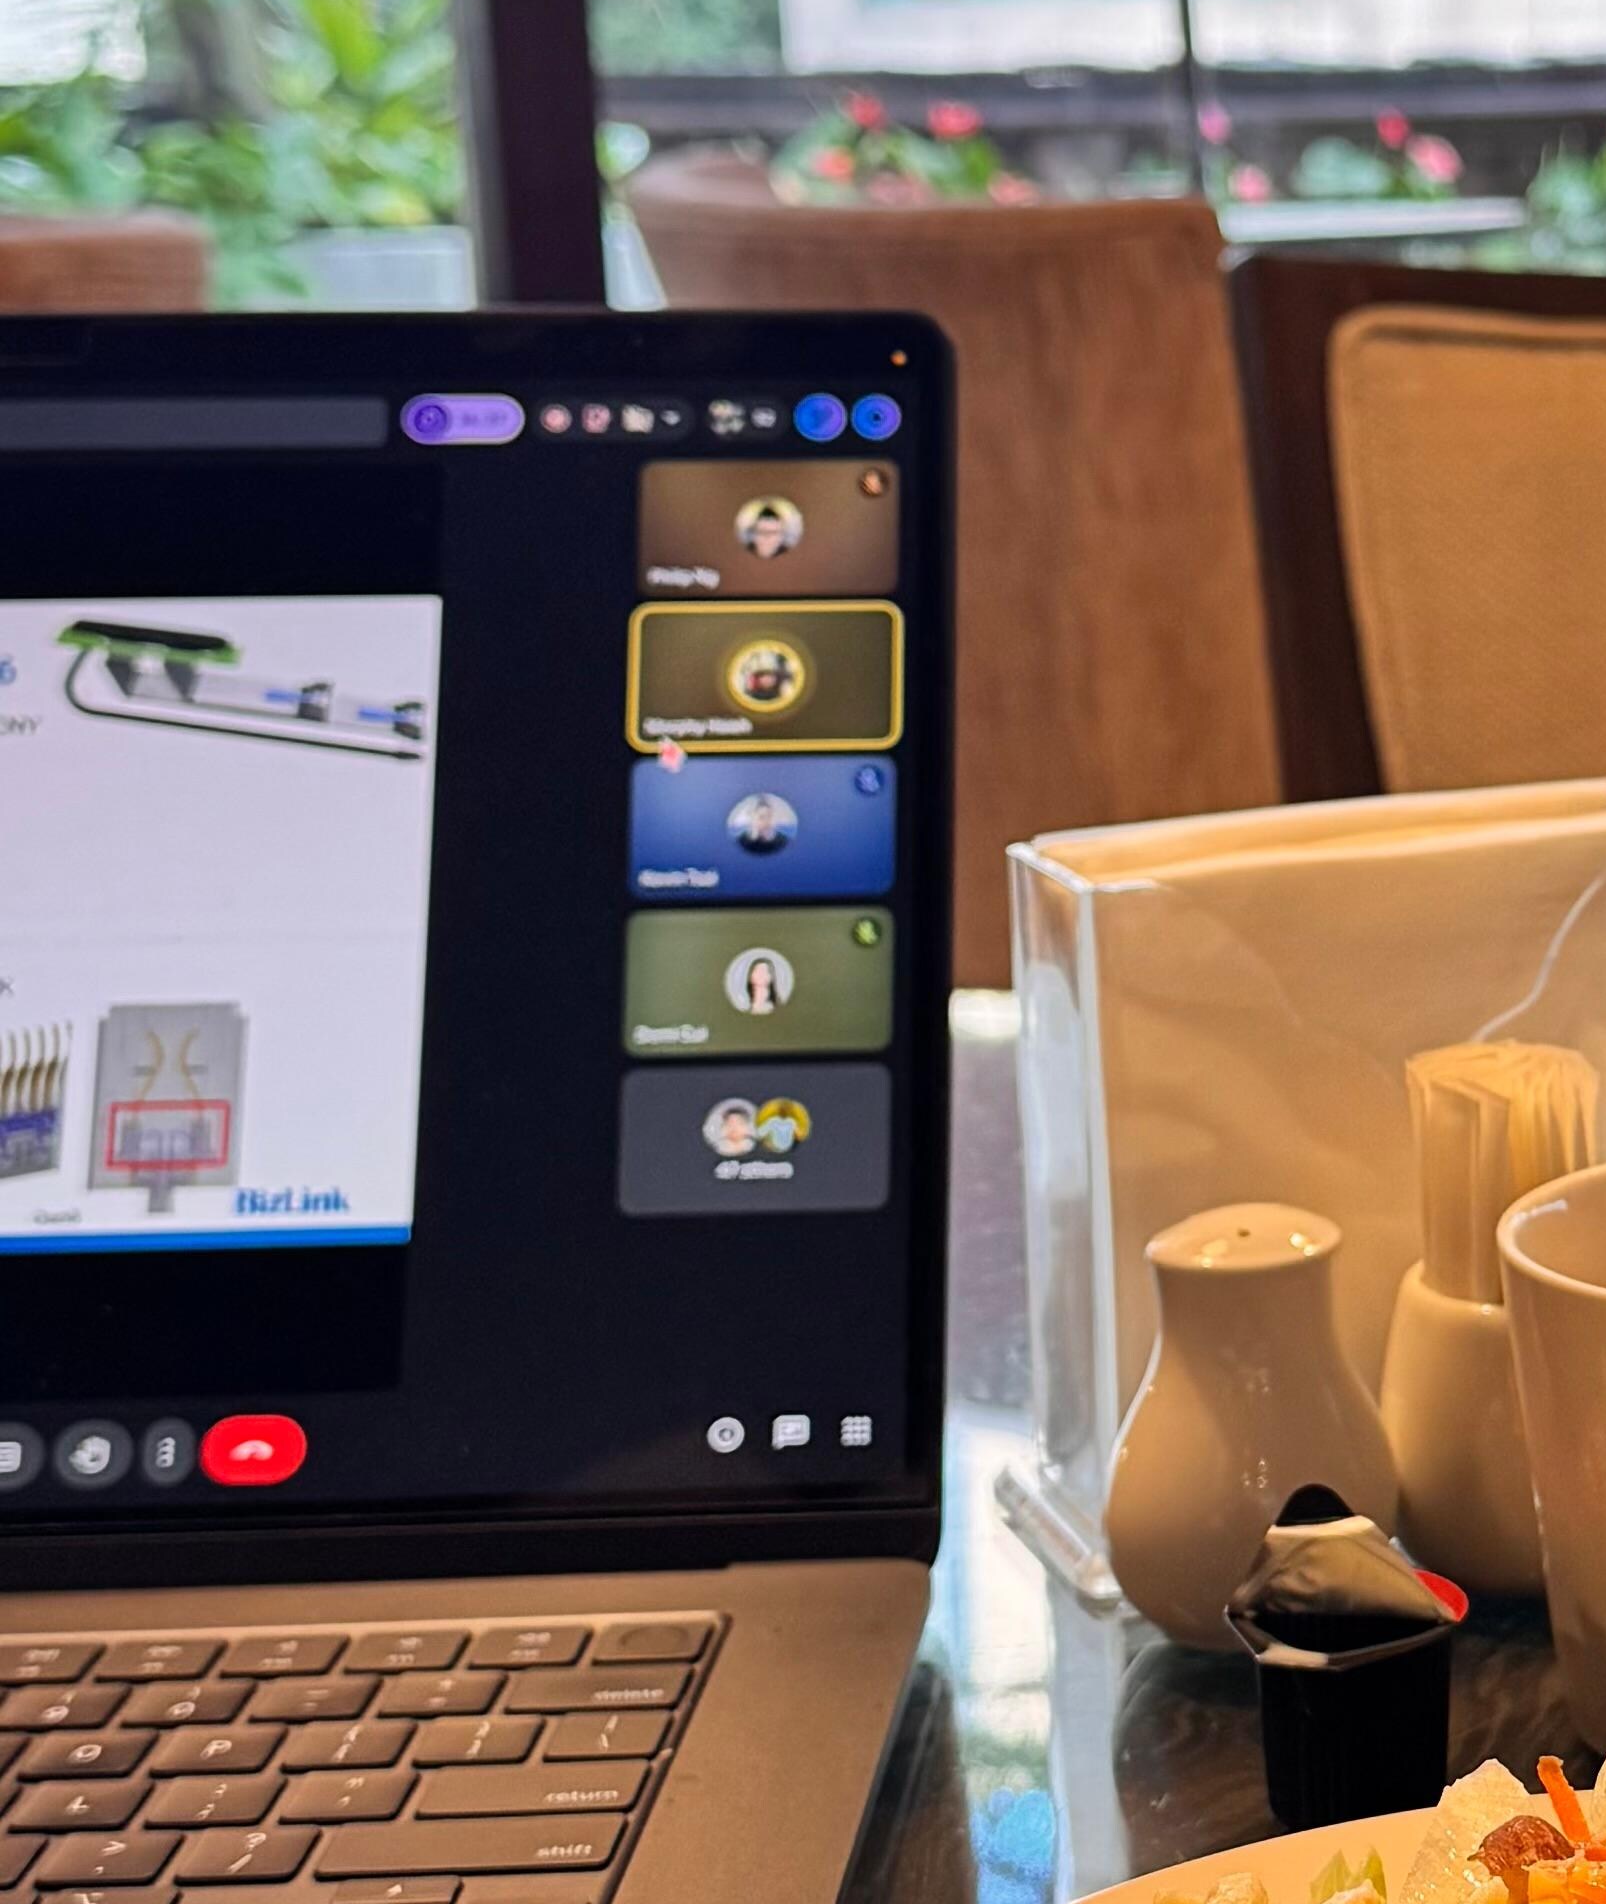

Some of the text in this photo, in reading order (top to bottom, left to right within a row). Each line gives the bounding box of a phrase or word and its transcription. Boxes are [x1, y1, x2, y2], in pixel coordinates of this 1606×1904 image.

[234, 1187, 349, 1215] BizLink
[199, 1738, 232, 1760] P
[546, 1789, 619, 1804] return
[535, 1843, 593, 1859] shift
